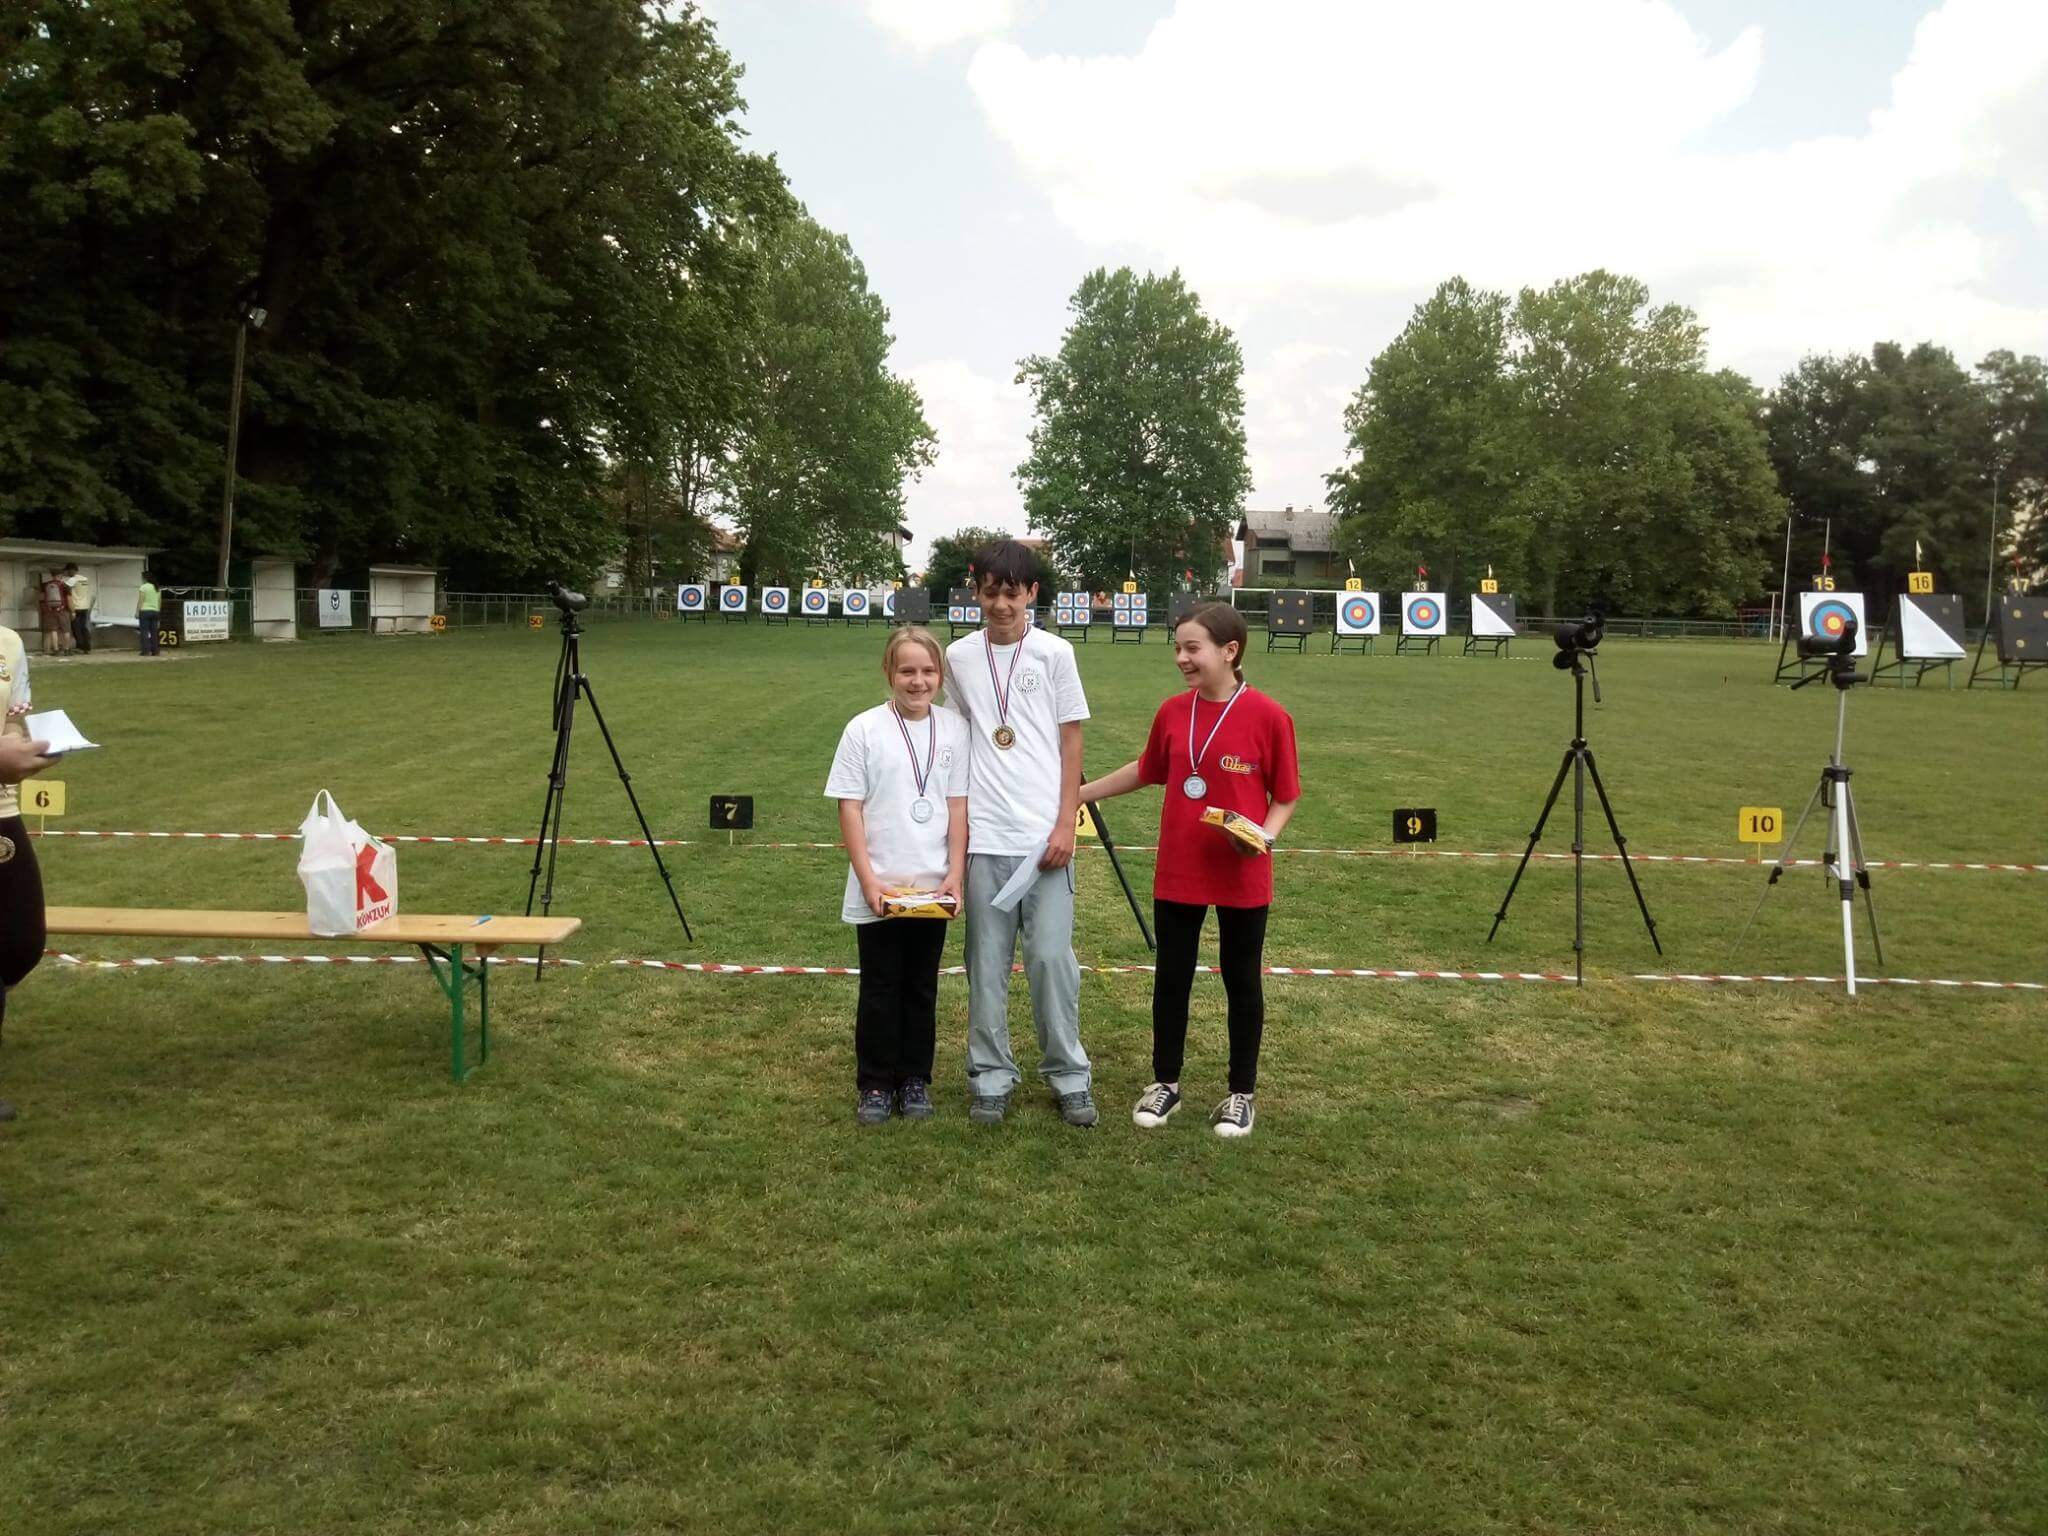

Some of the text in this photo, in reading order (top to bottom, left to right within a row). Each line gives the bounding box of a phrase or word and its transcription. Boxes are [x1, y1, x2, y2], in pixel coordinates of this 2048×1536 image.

[965, 578, 971, 587] 7
[1072, 581, 1078, 590] 9
[1127, 583, 1135, 592] 10
[1349, 580, 1360, 589] 12
[1415, 582, 1426, 592] 13
[1484, 582, 1496, 591] 14
[1814, 577, 1835, 591] 15
[1913, 576, 1930, 590] 16
[2010, 578, 2030, 592] 17
[431, 617, 445, 626] 40
[159, 631, 178, 646] 25
[35, 791, 50, 808] 6
[724, 802, 738, 820] 7
[1407, 817, 1422, 835] 9
[1749, 815, 1774, 833] 10
[354, 843, 388, 911] K
